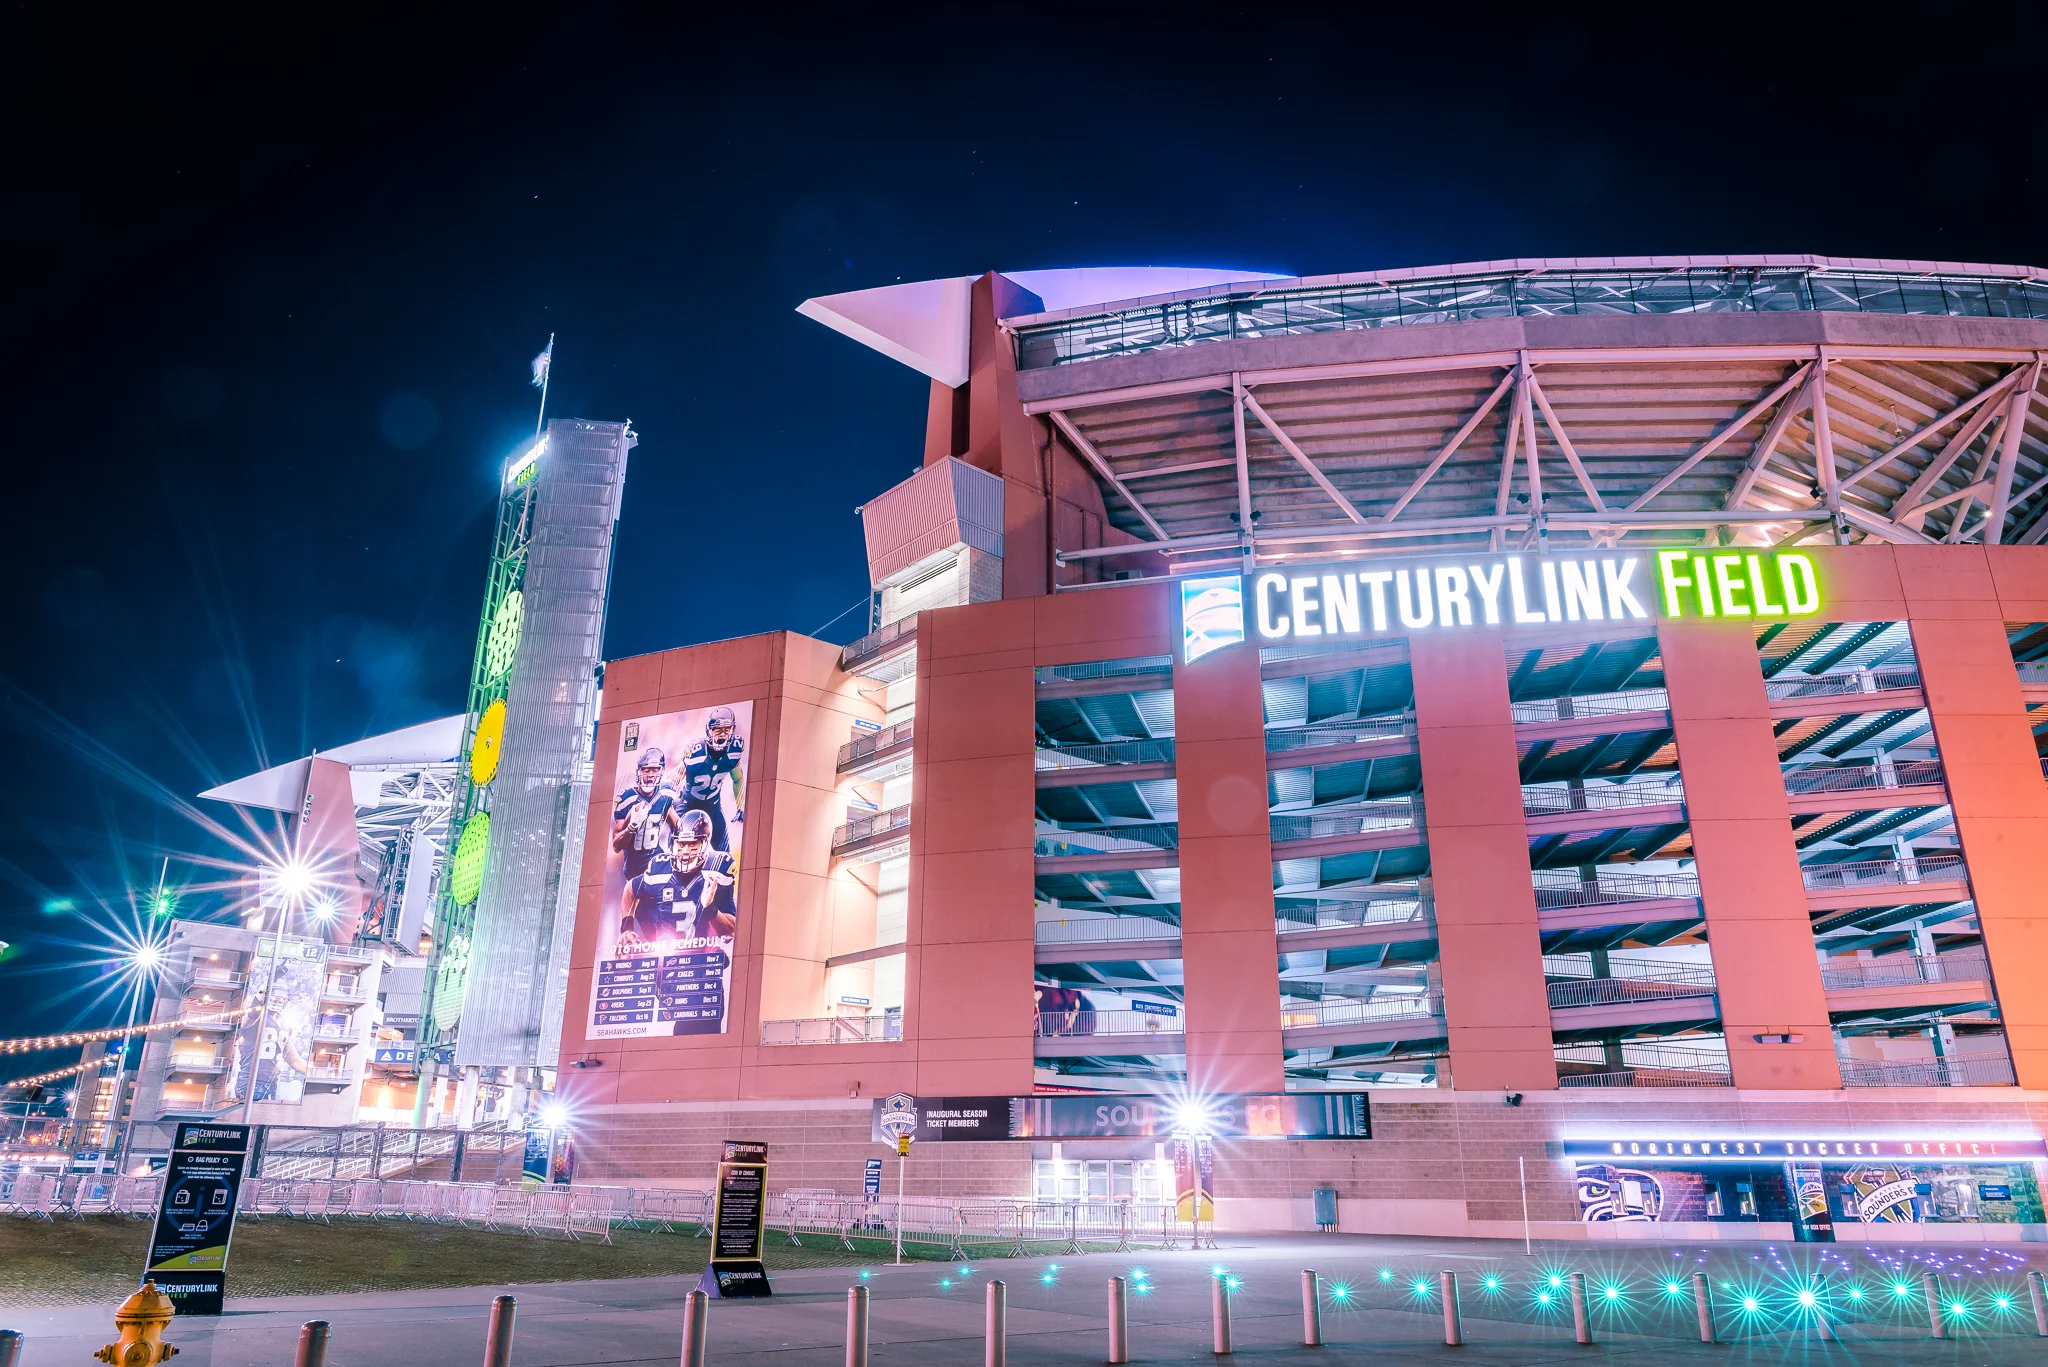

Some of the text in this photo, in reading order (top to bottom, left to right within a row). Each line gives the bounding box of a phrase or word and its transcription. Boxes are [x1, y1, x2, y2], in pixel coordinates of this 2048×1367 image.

[1256, 549, 1823, 639] CENTURYLINK FIELD
[604, 943, 630, 955] 2016
[671, 935, 726, 950] SCHEDULE
[305, 947, 318, 957] 12
[596, 1027, 647, 1037] SEAHAWKS.COM
[926, 1109, 988, 1118] INAUGURAL SEASON
[1244, 1104, 1278, 1127] FC
[882, 1115, 908, 1124] SOUNDERS
[926, 1119, 979, 1128] TICKET MEMBERS
[1612, 1141, 1999, 1156] NORTHWEST TICKET OFFICE
[1864, 1188, 1908, 1220] SOUNDERS
[166, 1284, 218, 1293] CENTURYLINK
